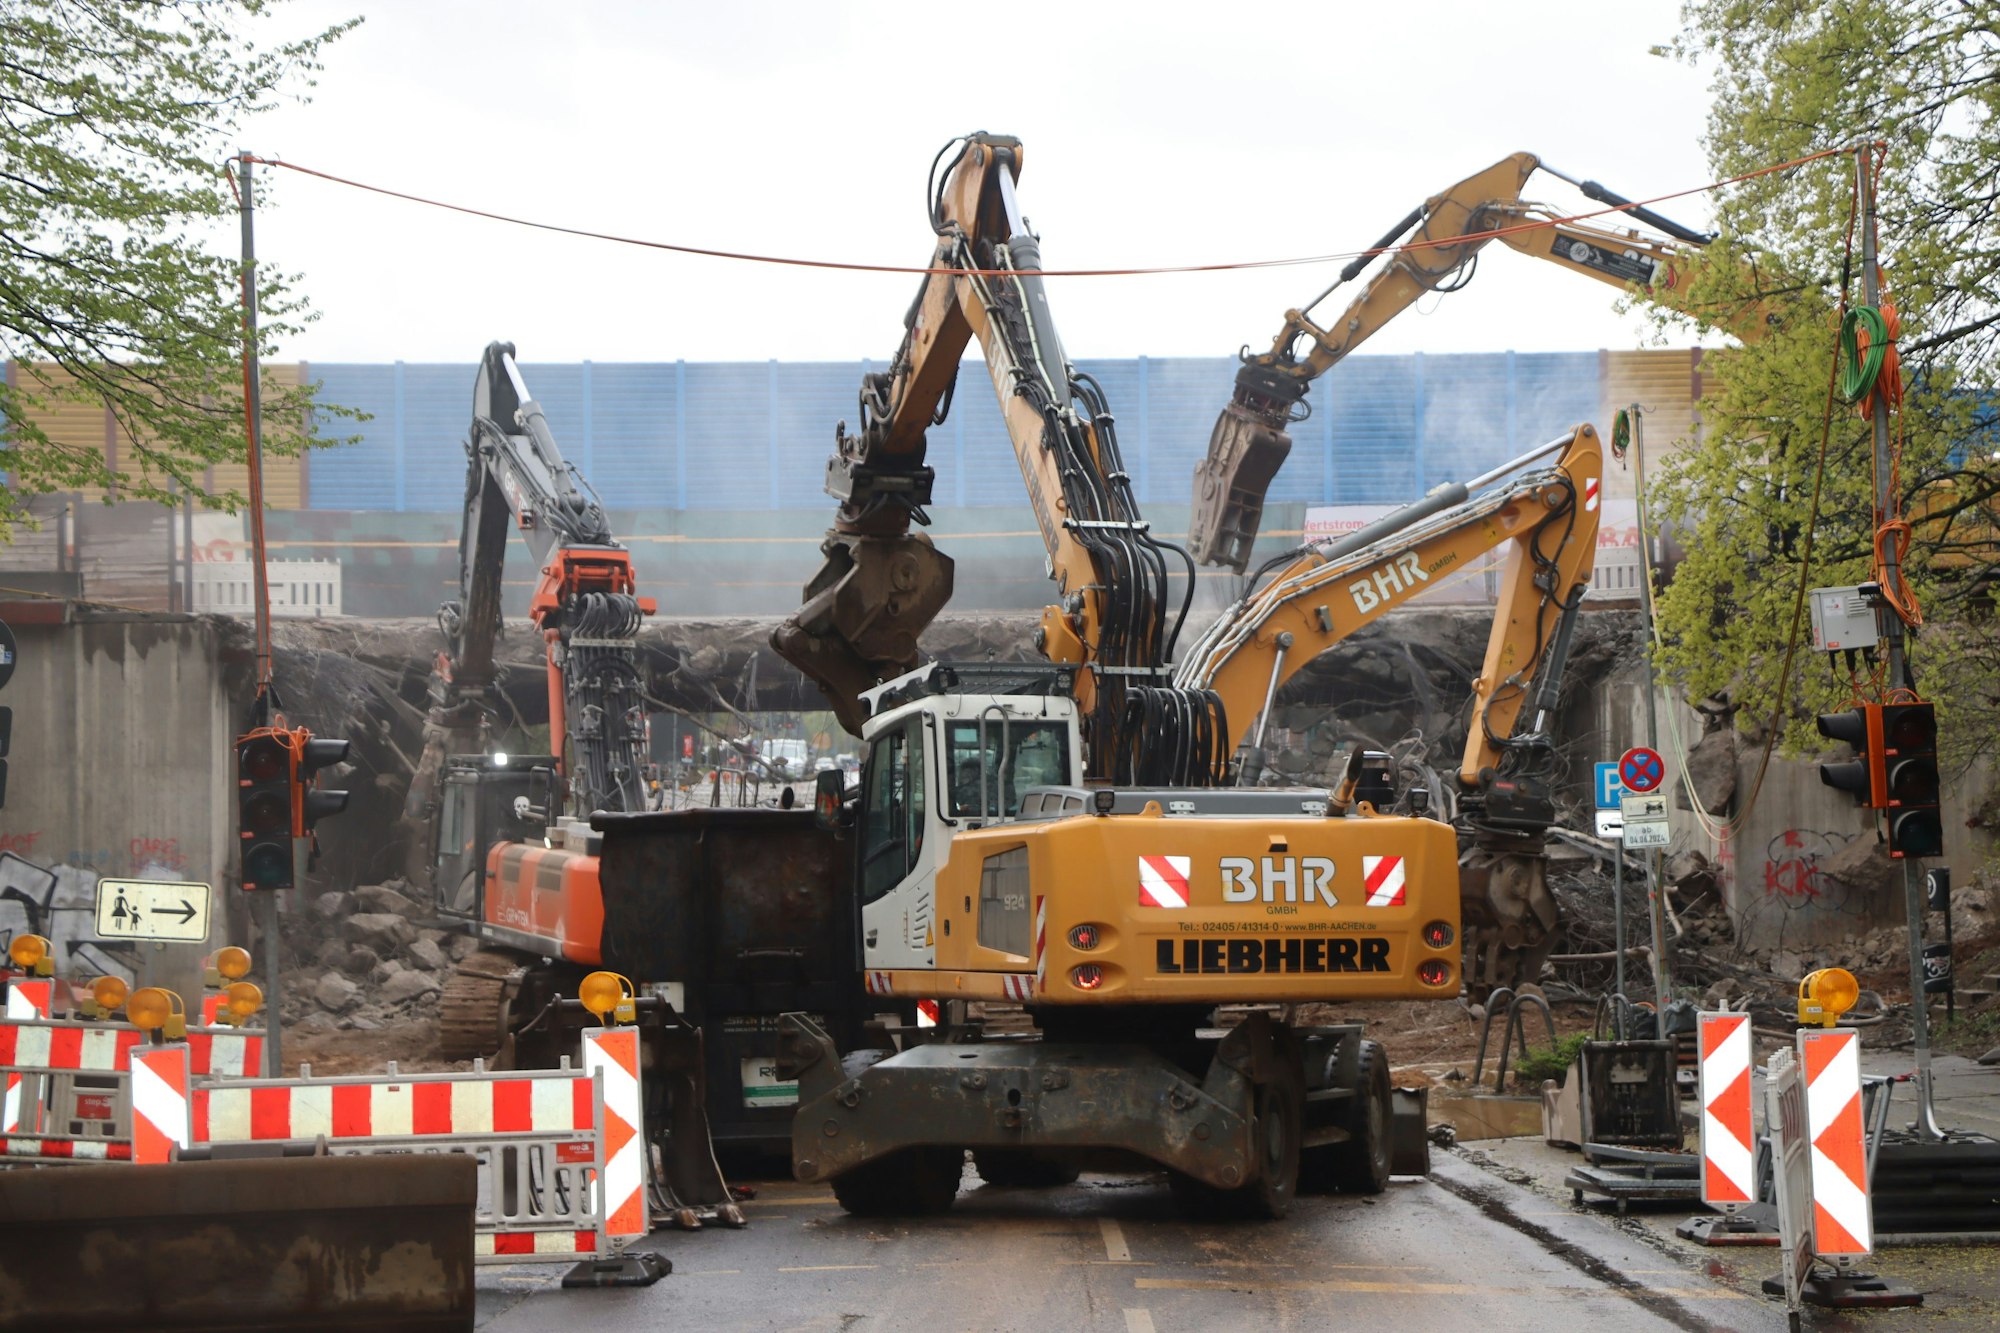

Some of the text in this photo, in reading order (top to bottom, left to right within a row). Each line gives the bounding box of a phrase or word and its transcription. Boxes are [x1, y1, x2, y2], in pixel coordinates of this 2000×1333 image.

[1348, 551, 1457, 614] BHR GMBH
[1641, 826, 1652, 834] ab
[1219, 856, 1339, 908] BHR
[1004, 894, 1025, 911] 924
[1266, 906, 1298, 915] GMBH
[1178, 921, 1200, 931] Tel.:
[1156, 938, 1391, 974] LIEBHERR
